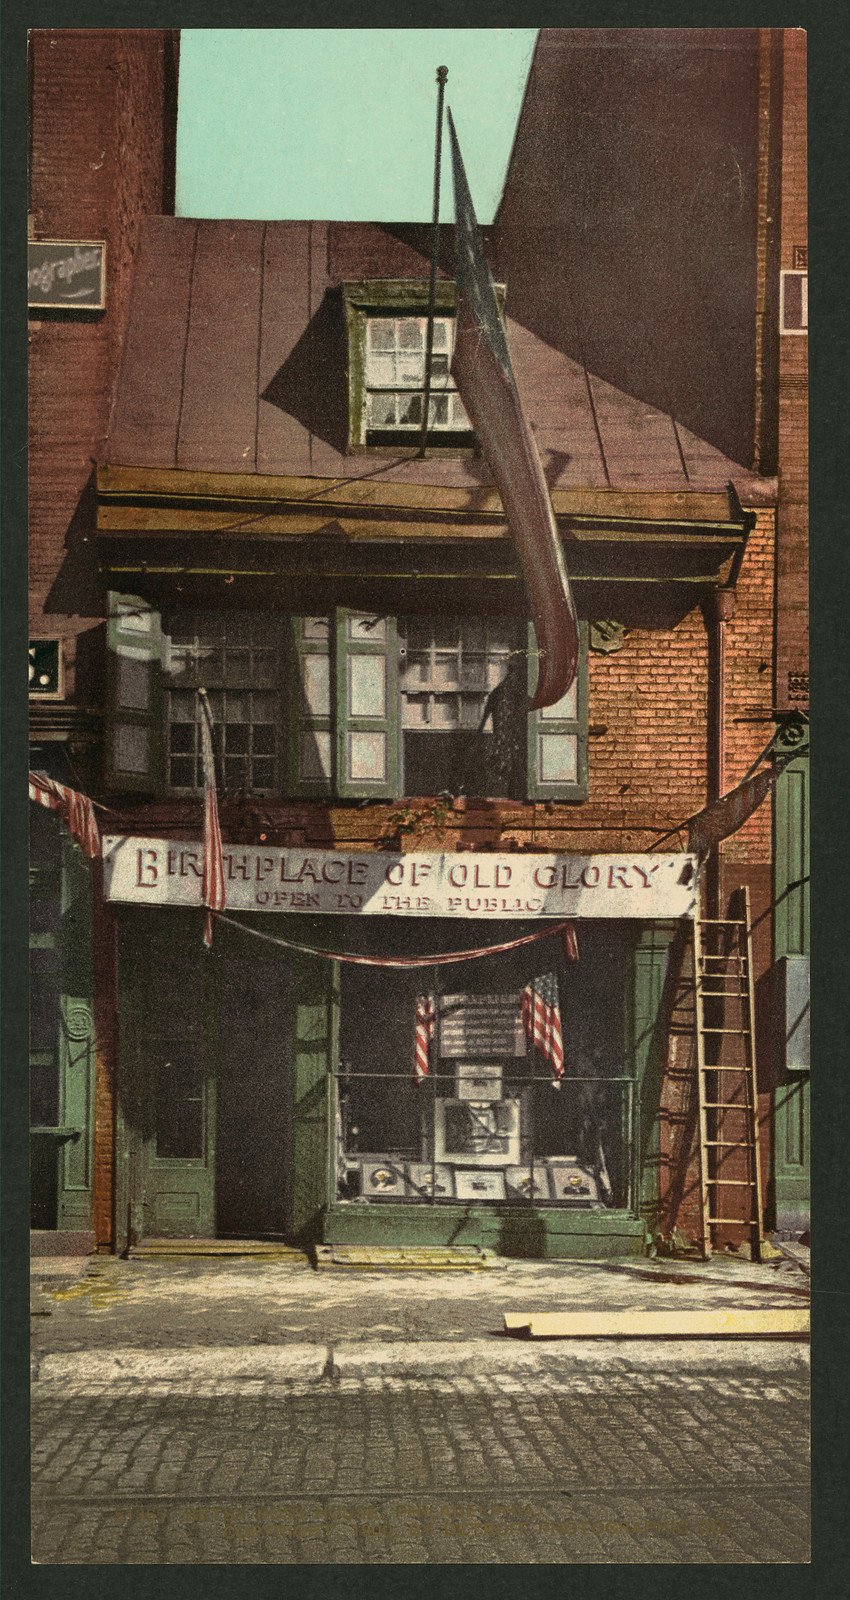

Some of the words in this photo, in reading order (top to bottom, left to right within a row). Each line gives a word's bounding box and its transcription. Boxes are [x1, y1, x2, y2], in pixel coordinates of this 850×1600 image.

[137, 848, 368, 888] BIRHPLACE
[385, 863, 432, 888] OF
[450, 863, 513, 889] OLD
[534, 863, 660, 889] GLORY
[256, 891, 320, 908] OPEN
[336, 893, 364, 909] TO
[381, 894, 431, 911] THE
